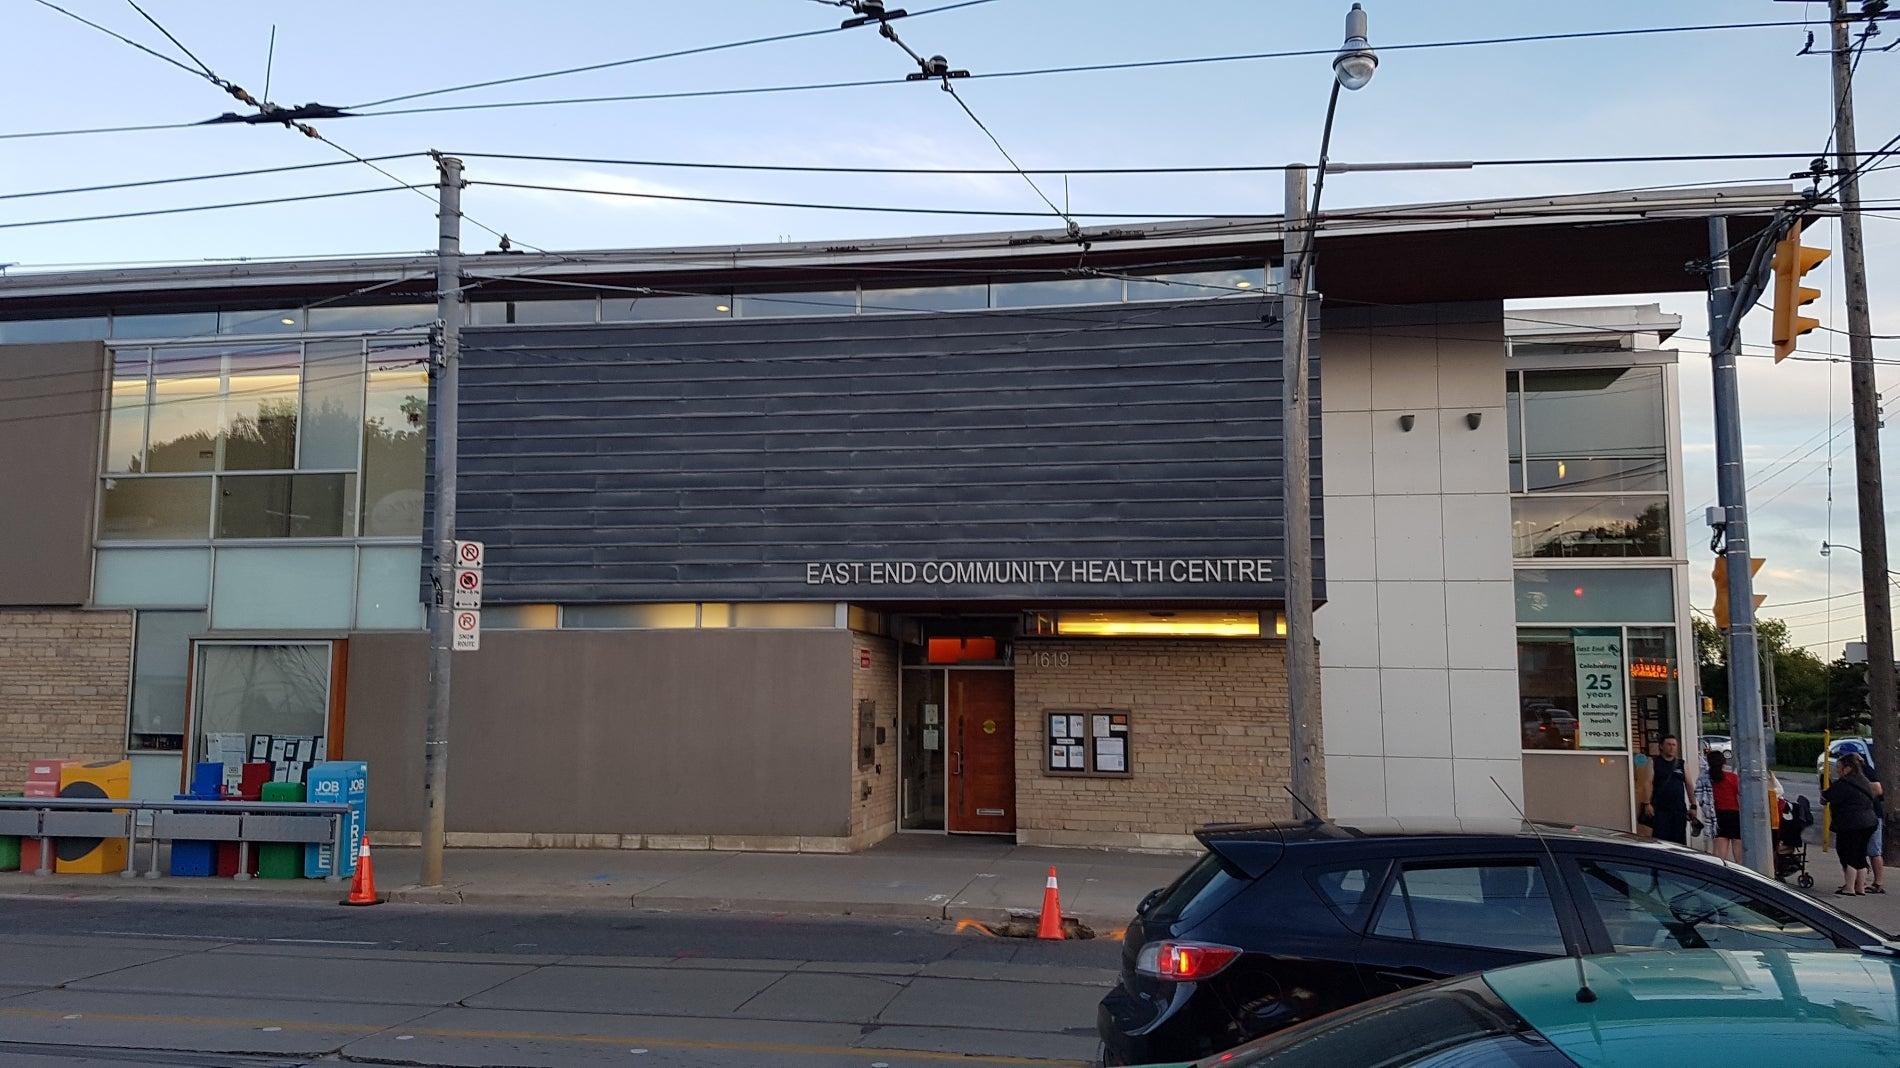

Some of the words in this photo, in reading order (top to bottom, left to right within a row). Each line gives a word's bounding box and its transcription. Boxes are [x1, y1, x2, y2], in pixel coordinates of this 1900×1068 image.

[806, 562, 864, 585] EAST
[870, 562, 917, 584] END
[922, 561, 1065, 584] COMMUNITY
[1071, 560, 1164, 583] HEALTH
[1169, 559, 1274, 582] CENTRE
[1034, 651, 1069, 668] 1619
[1586, 674, 1612, 690] 25
[315, 781, 340, 792] JOB
[349, 778, 365, 791] JOB
[350, 811, 360, 867] FREE
